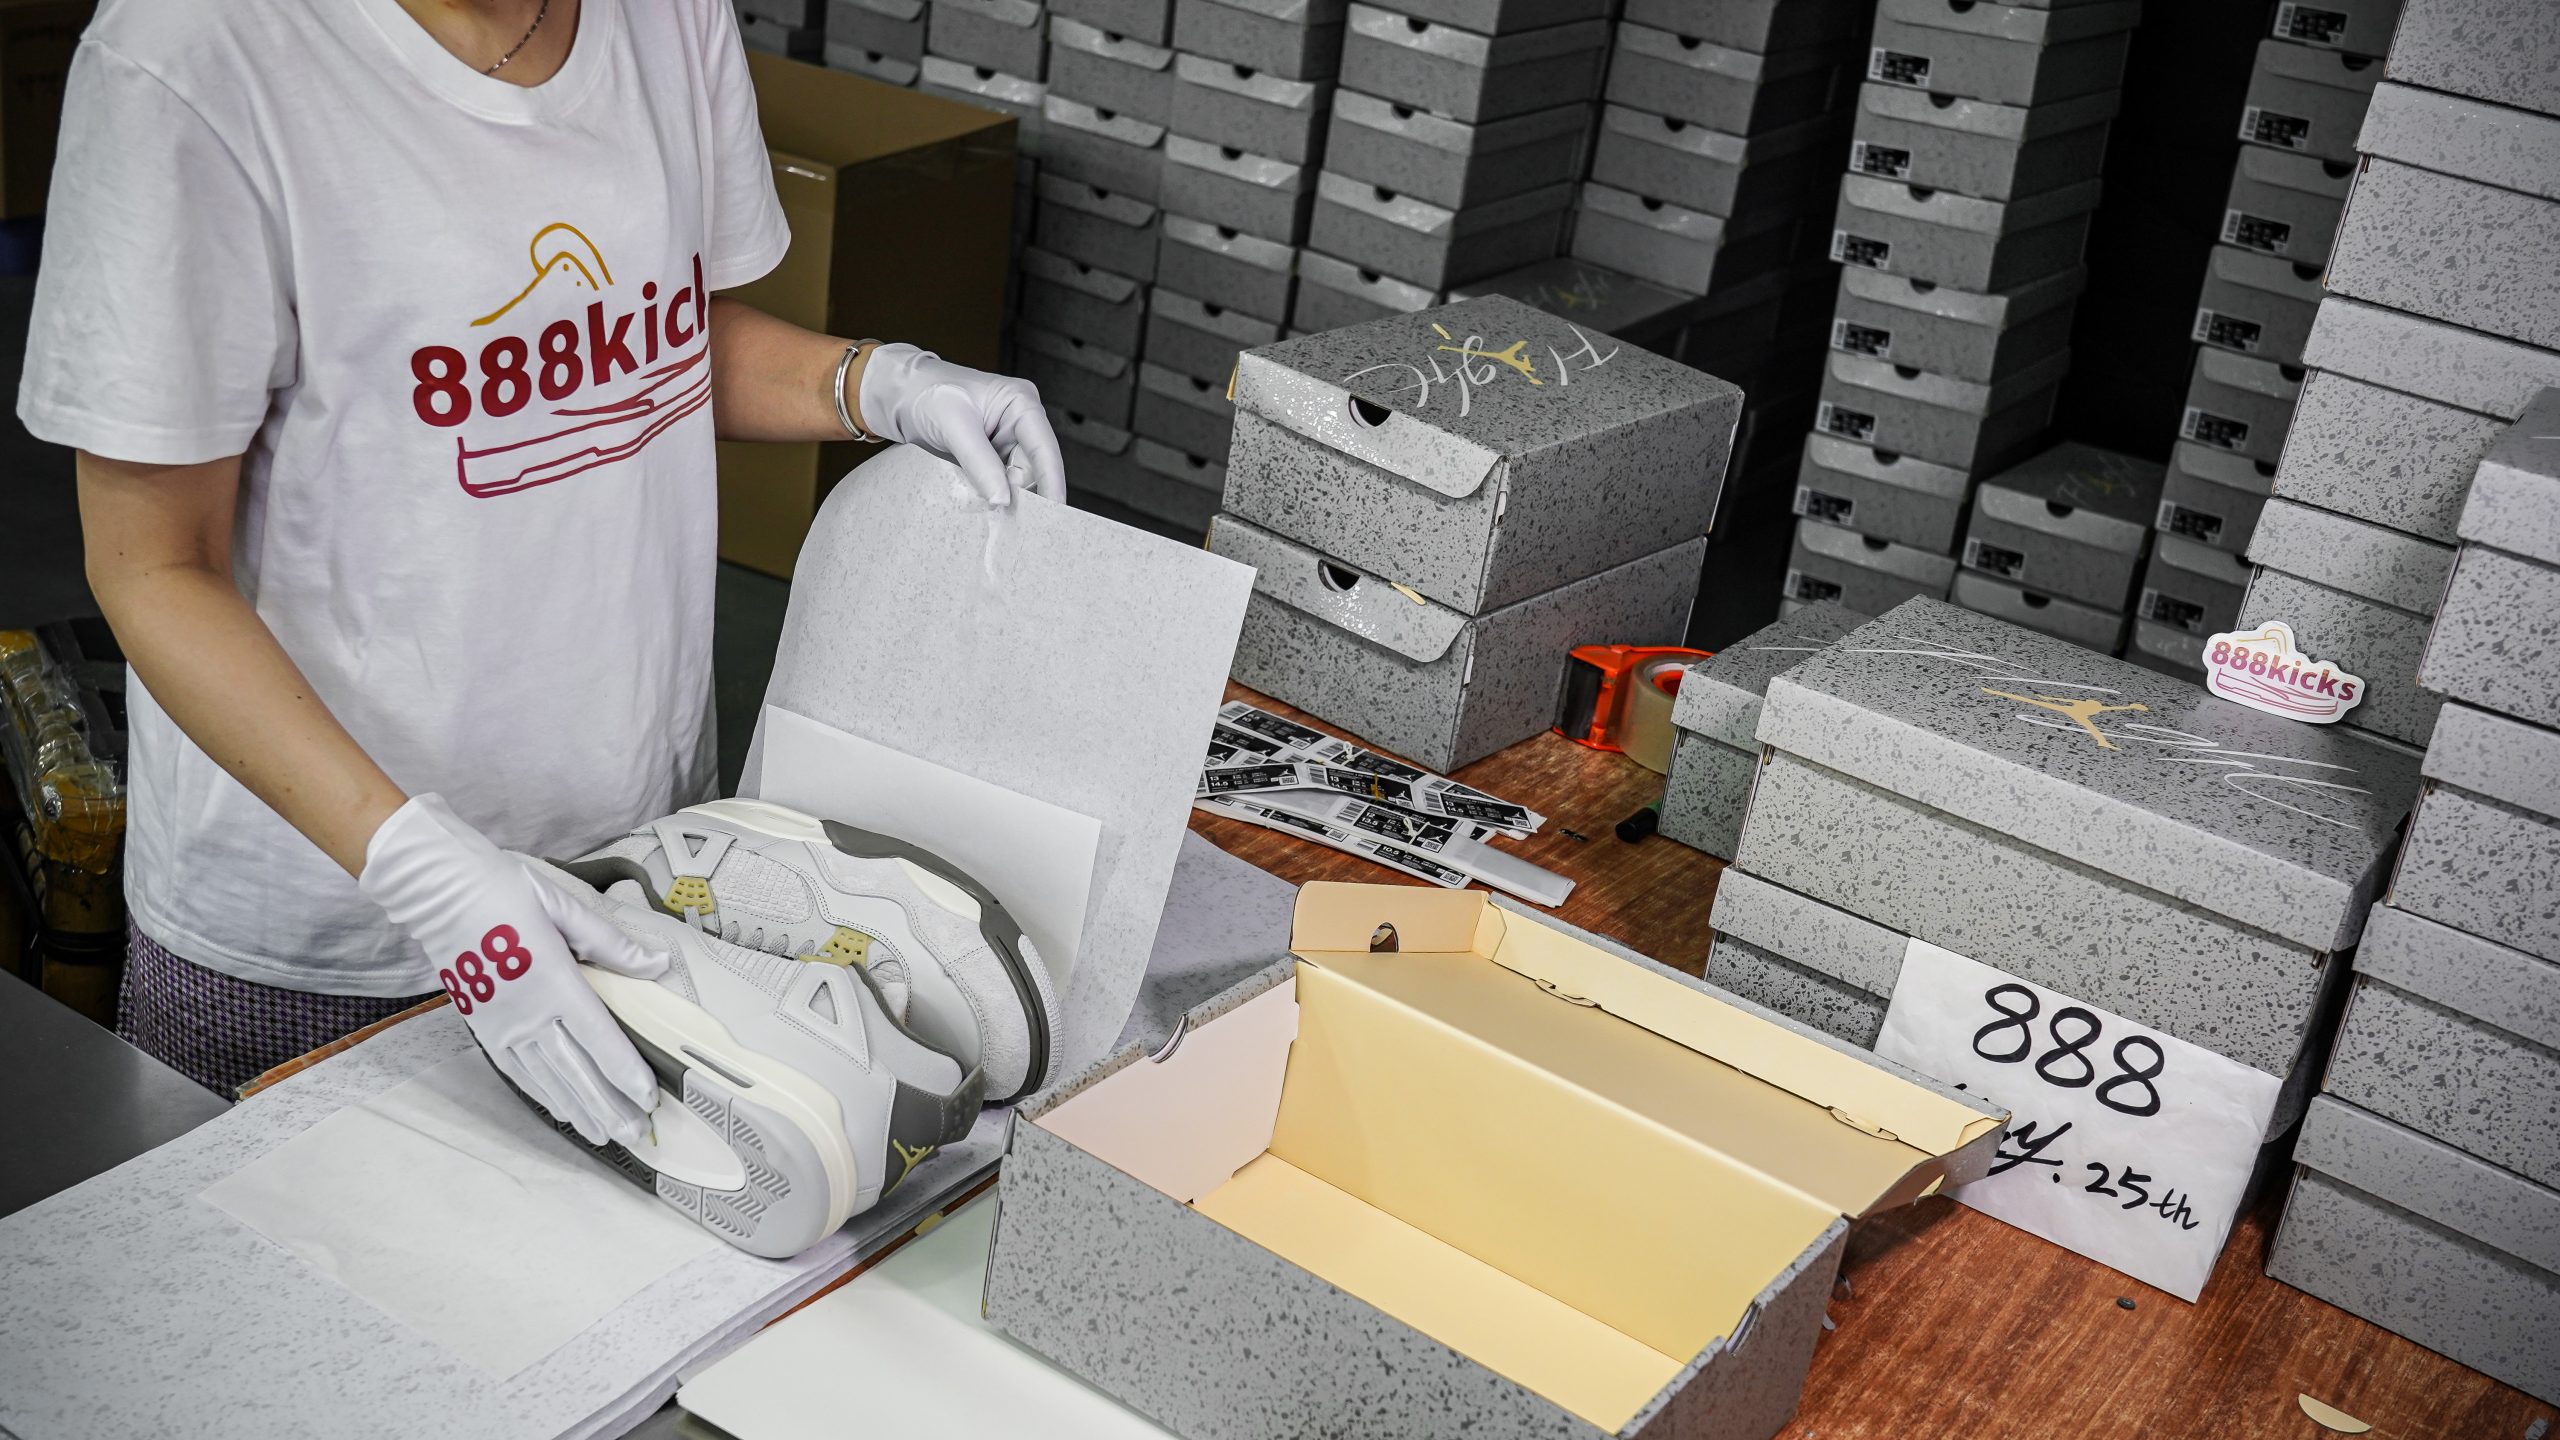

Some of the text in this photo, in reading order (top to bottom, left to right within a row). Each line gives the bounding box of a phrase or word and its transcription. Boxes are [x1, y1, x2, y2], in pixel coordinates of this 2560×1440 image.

[2211, 641, 2357, 701] 888kicks
[1330, 775, 1340, 783] 13
[1361, 817, 1379, 826] 13.5
[1382, 845, 1400, 855] 10.5
[439, 924, 533, 1016] 888
[1973, 983, 2165, 1117] 888
[2085, 1162, 2200, 1230] 25th
